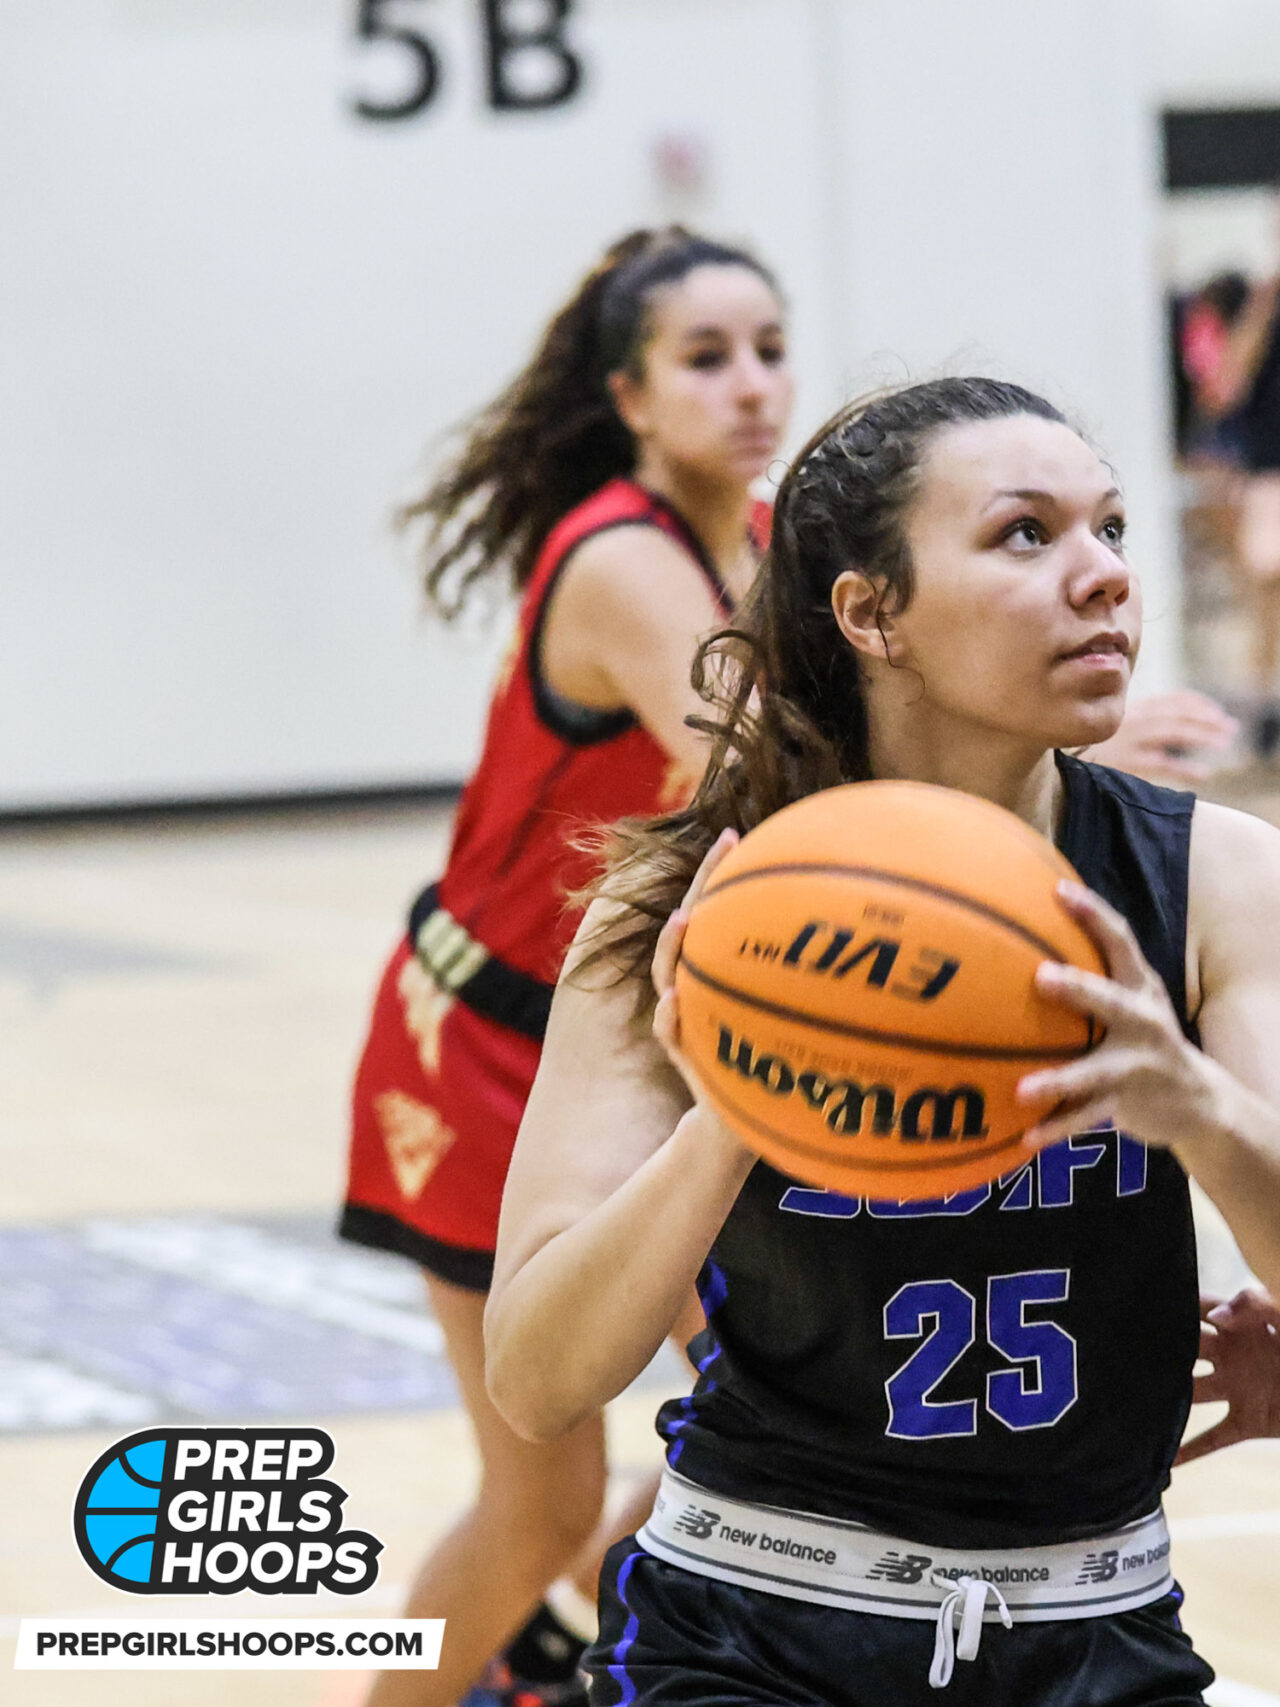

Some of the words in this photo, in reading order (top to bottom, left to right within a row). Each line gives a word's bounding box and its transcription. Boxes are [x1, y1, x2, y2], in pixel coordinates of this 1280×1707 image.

[353, 0, 584, 122] 5B
[883, 1268, 1078, 1440] 25
[719, 1524, 757, 1547] new
[758, 1533, 837, 1566] balance
[1122, 1553, 1146, 1572] new
[980, 1565, 1050, 1582] balance
